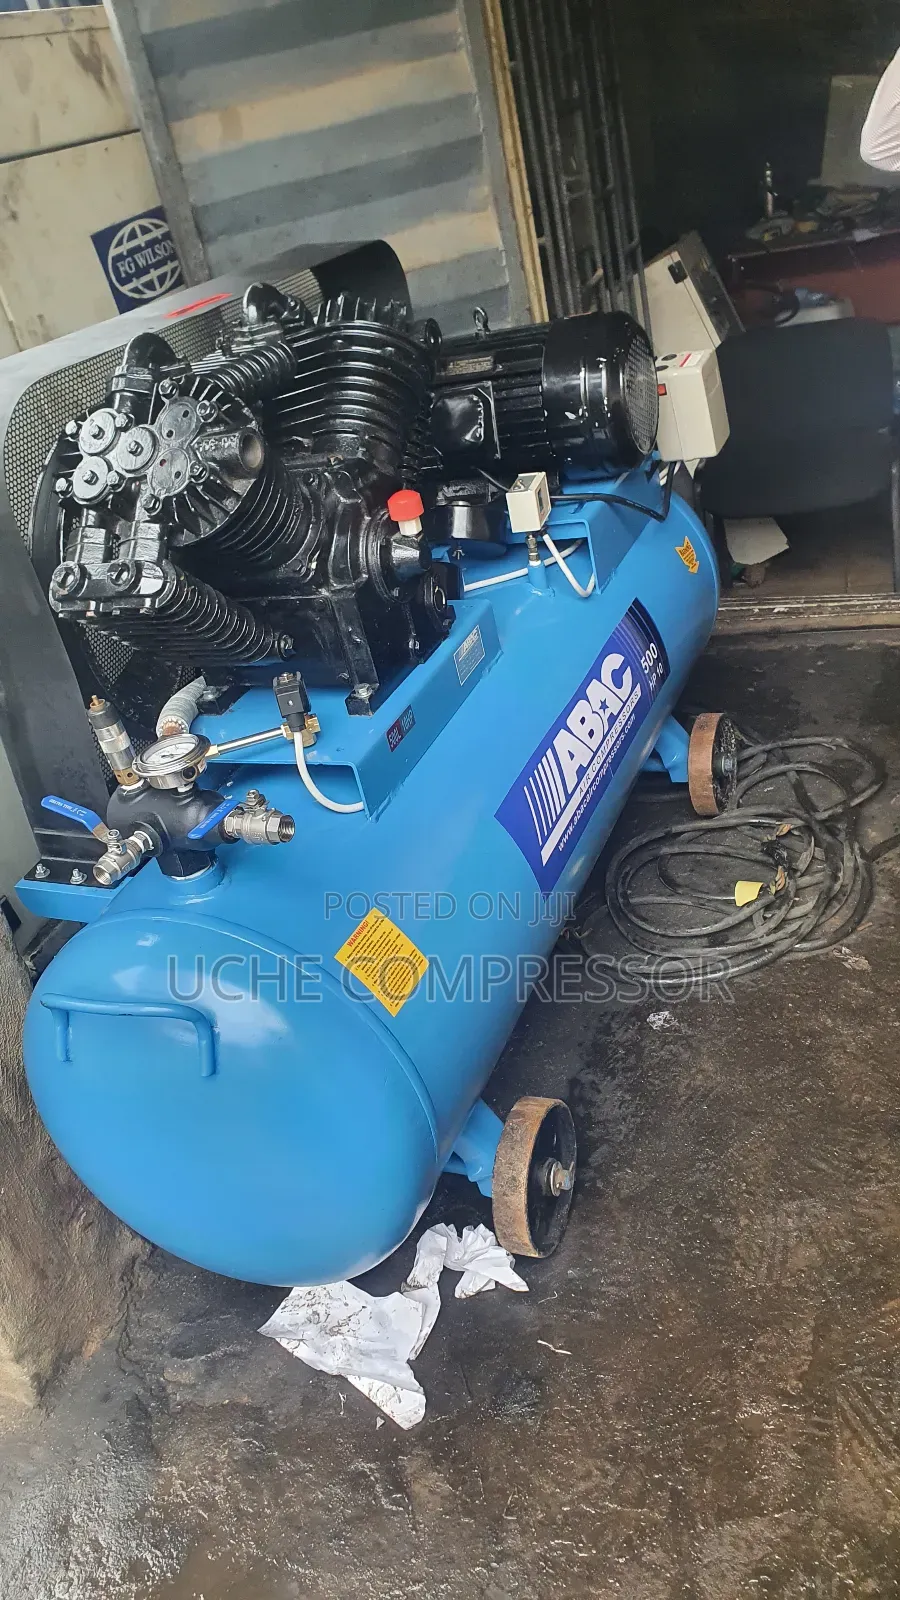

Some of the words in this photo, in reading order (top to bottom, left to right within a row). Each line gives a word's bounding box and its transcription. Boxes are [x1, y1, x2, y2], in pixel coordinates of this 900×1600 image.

[117, 257, 136, 278] FG
[641, 643, 658, 674] 500
[553, 653, 633, 795] ABAC
[578, 772, 592, 797] AIR
[591, 691, 639, 773] COMPRESSORS
[558, 714, 637, 852] www.abacaircompressors.com
[346, 919, 370, 948] WARNING!
